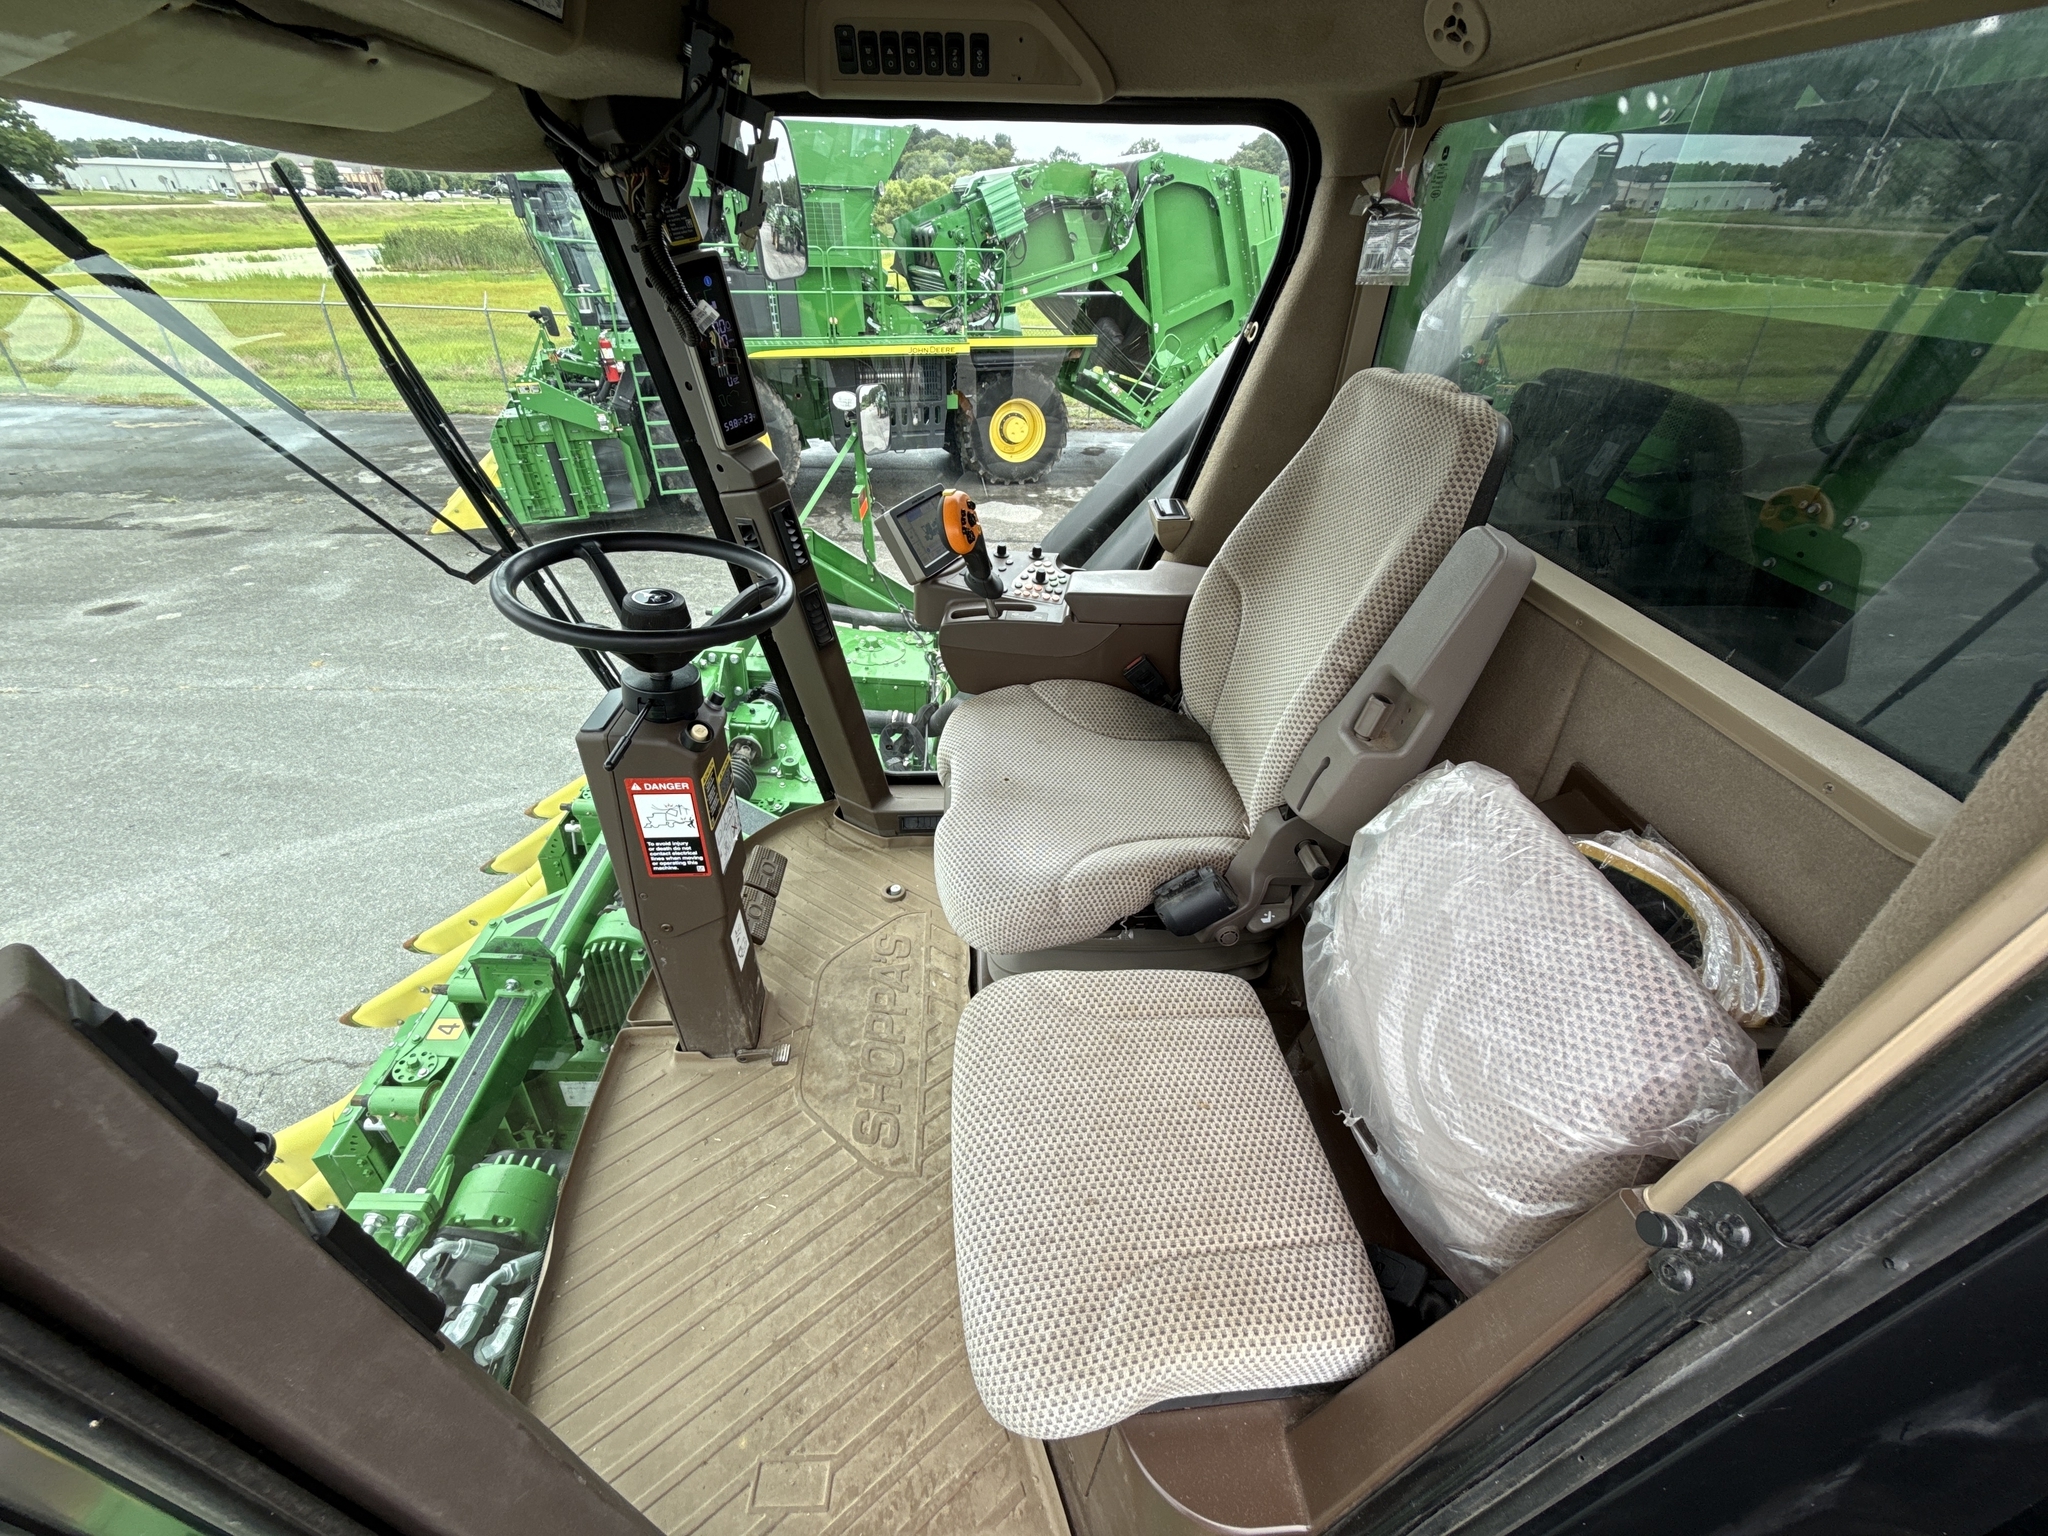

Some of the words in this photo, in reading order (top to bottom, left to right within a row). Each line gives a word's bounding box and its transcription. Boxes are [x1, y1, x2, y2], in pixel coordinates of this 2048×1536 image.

[929, 345, 956, 353] DEERE
[643, 782, 690, 791] DANGER
[437, 1023, 460, 1035] 4
[851, 933, 912, 1150] SHOPPA'S
